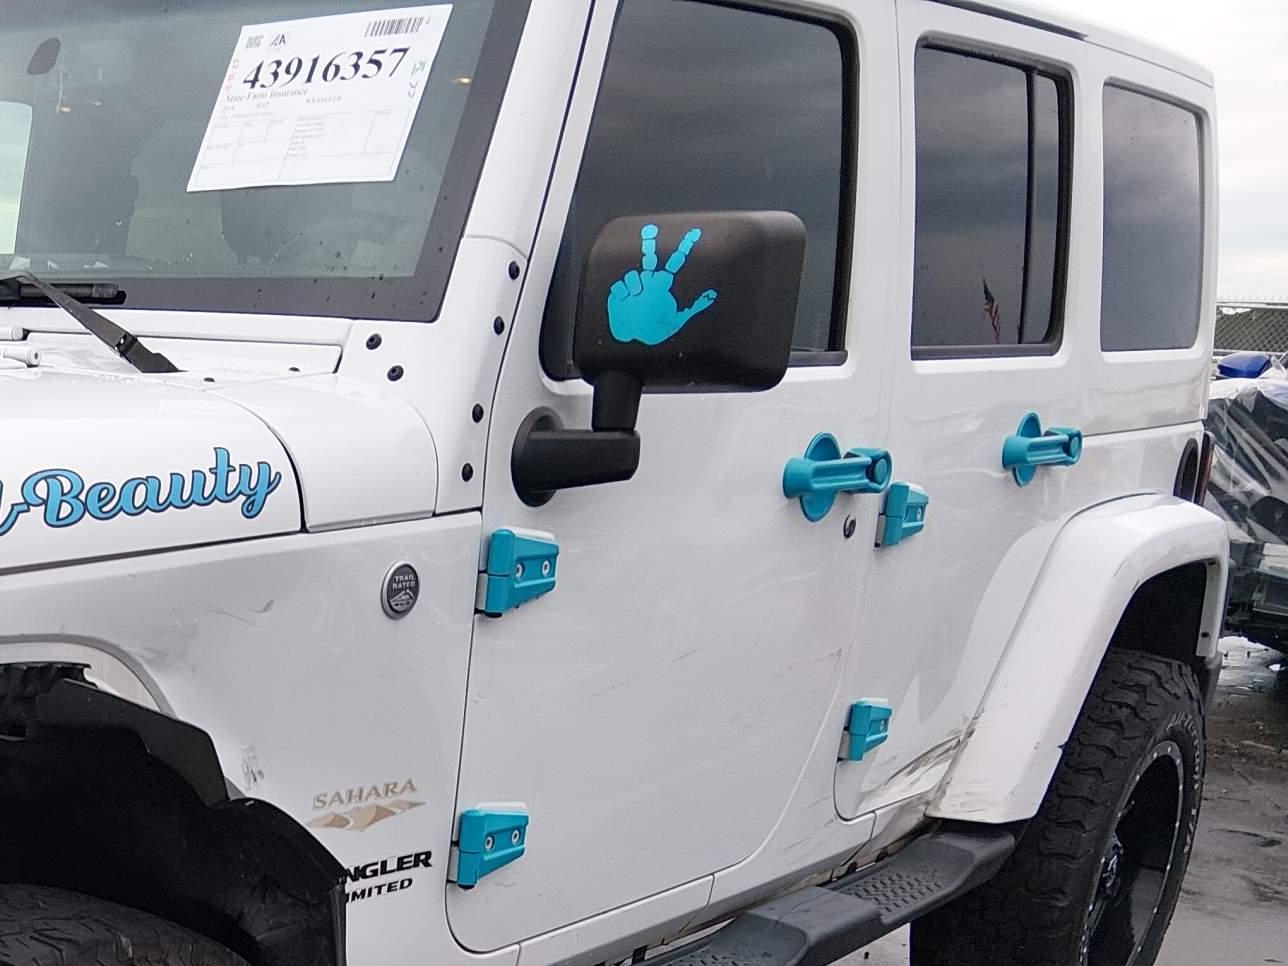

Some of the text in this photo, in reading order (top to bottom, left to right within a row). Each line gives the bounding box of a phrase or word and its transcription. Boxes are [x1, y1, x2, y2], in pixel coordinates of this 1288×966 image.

[243, 47, 411, 89] 43916357
[247, 91, 267, 100] Farm
[269, 88, 309, 99] Insurance
[312, 777, 417, 809] SAHARA
[344, 850, 433, 884] NGLER
[345, 878, 413, 904] IMITED
